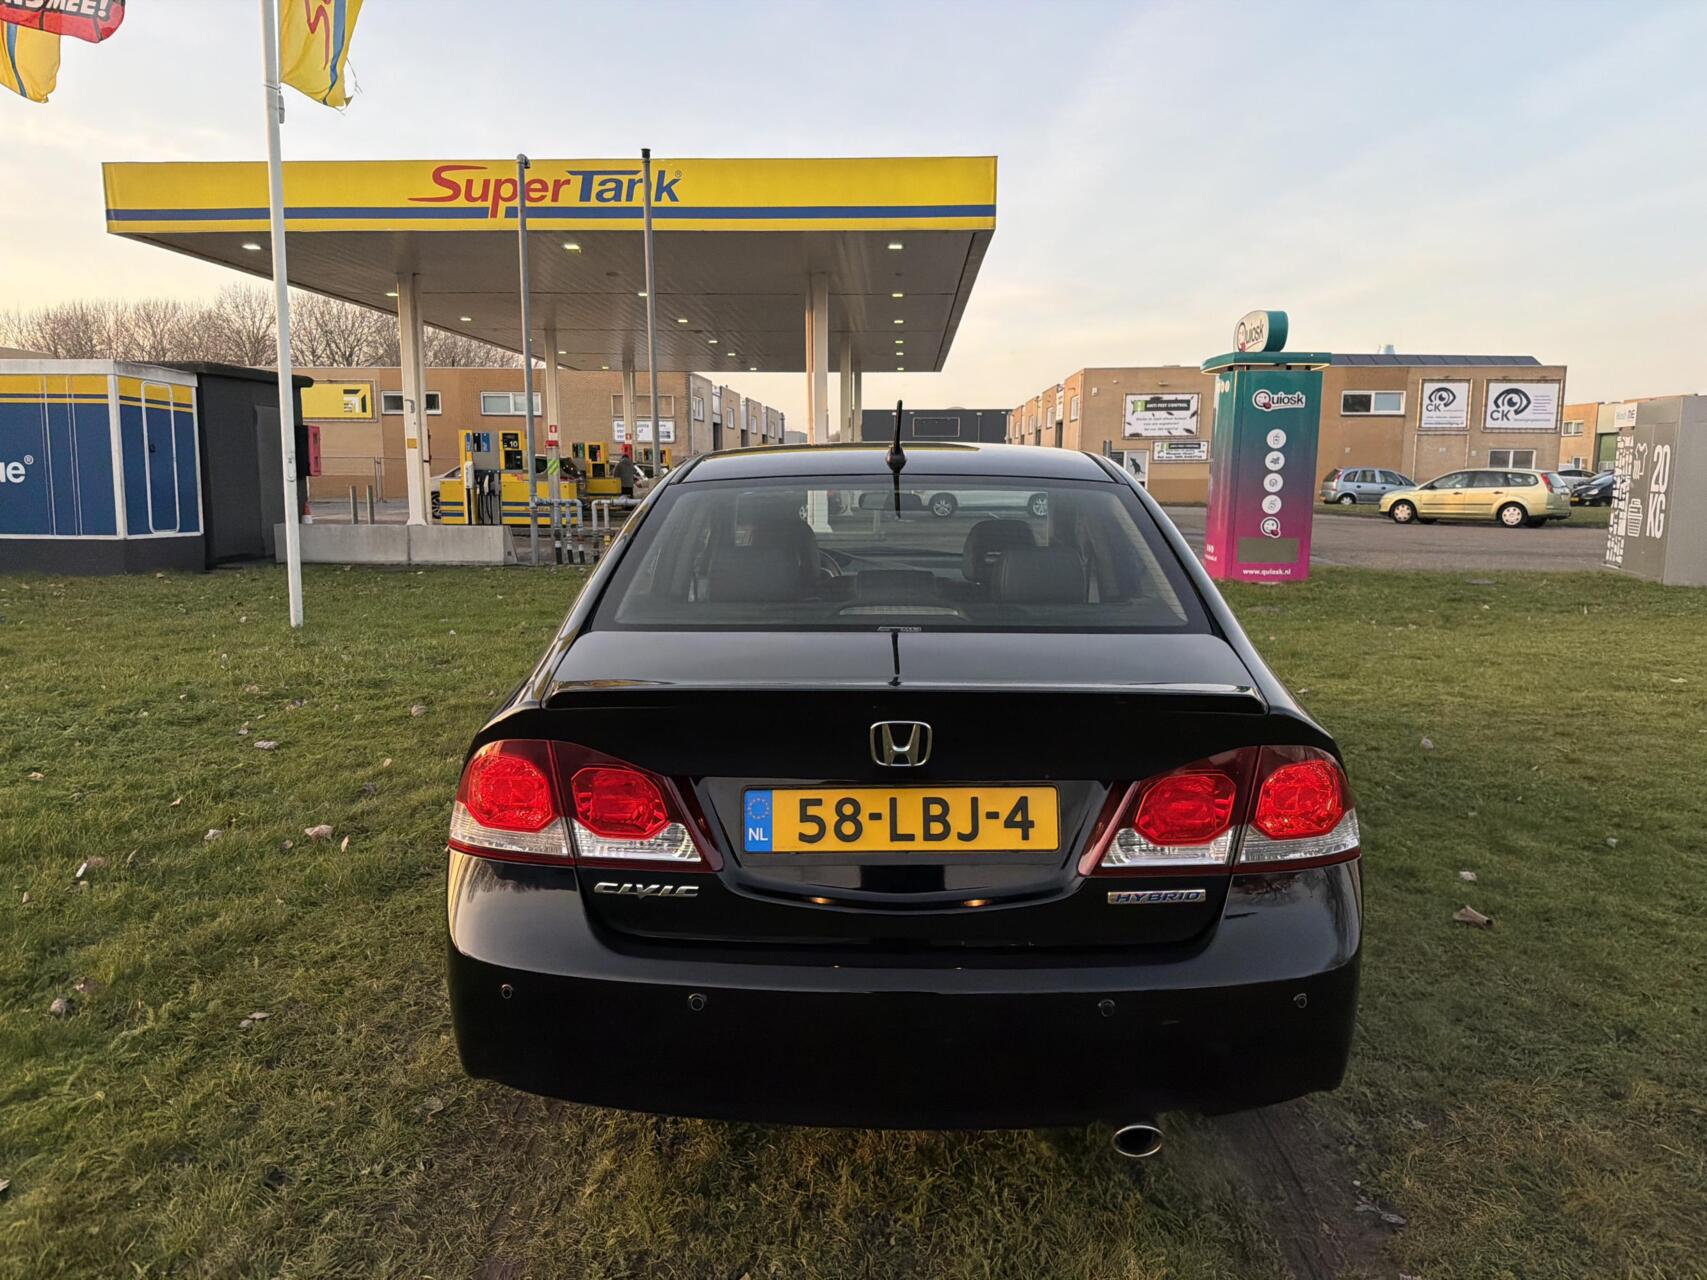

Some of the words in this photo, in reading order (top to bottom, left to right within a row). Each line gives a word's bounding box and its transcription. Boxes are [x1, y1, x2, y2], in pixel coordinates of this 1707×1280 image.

[1237, 319, 1264, 352] Quiosk
[1253, 390, 1305, 409] Quiosk
[1425, 403, 1442, 412] CK
[1490, 409, 1511, 422] CK
[1650, 444, 1671, 494] 20
[1646, 493, 1666, 539] KG
[798, 796, 1035, 844] 58-LBJ-4
[748, 827, 769, 842] NL
[594, 881, 700, 900] CIVIC
[1115, 889, 1202, 903] HYBRID
